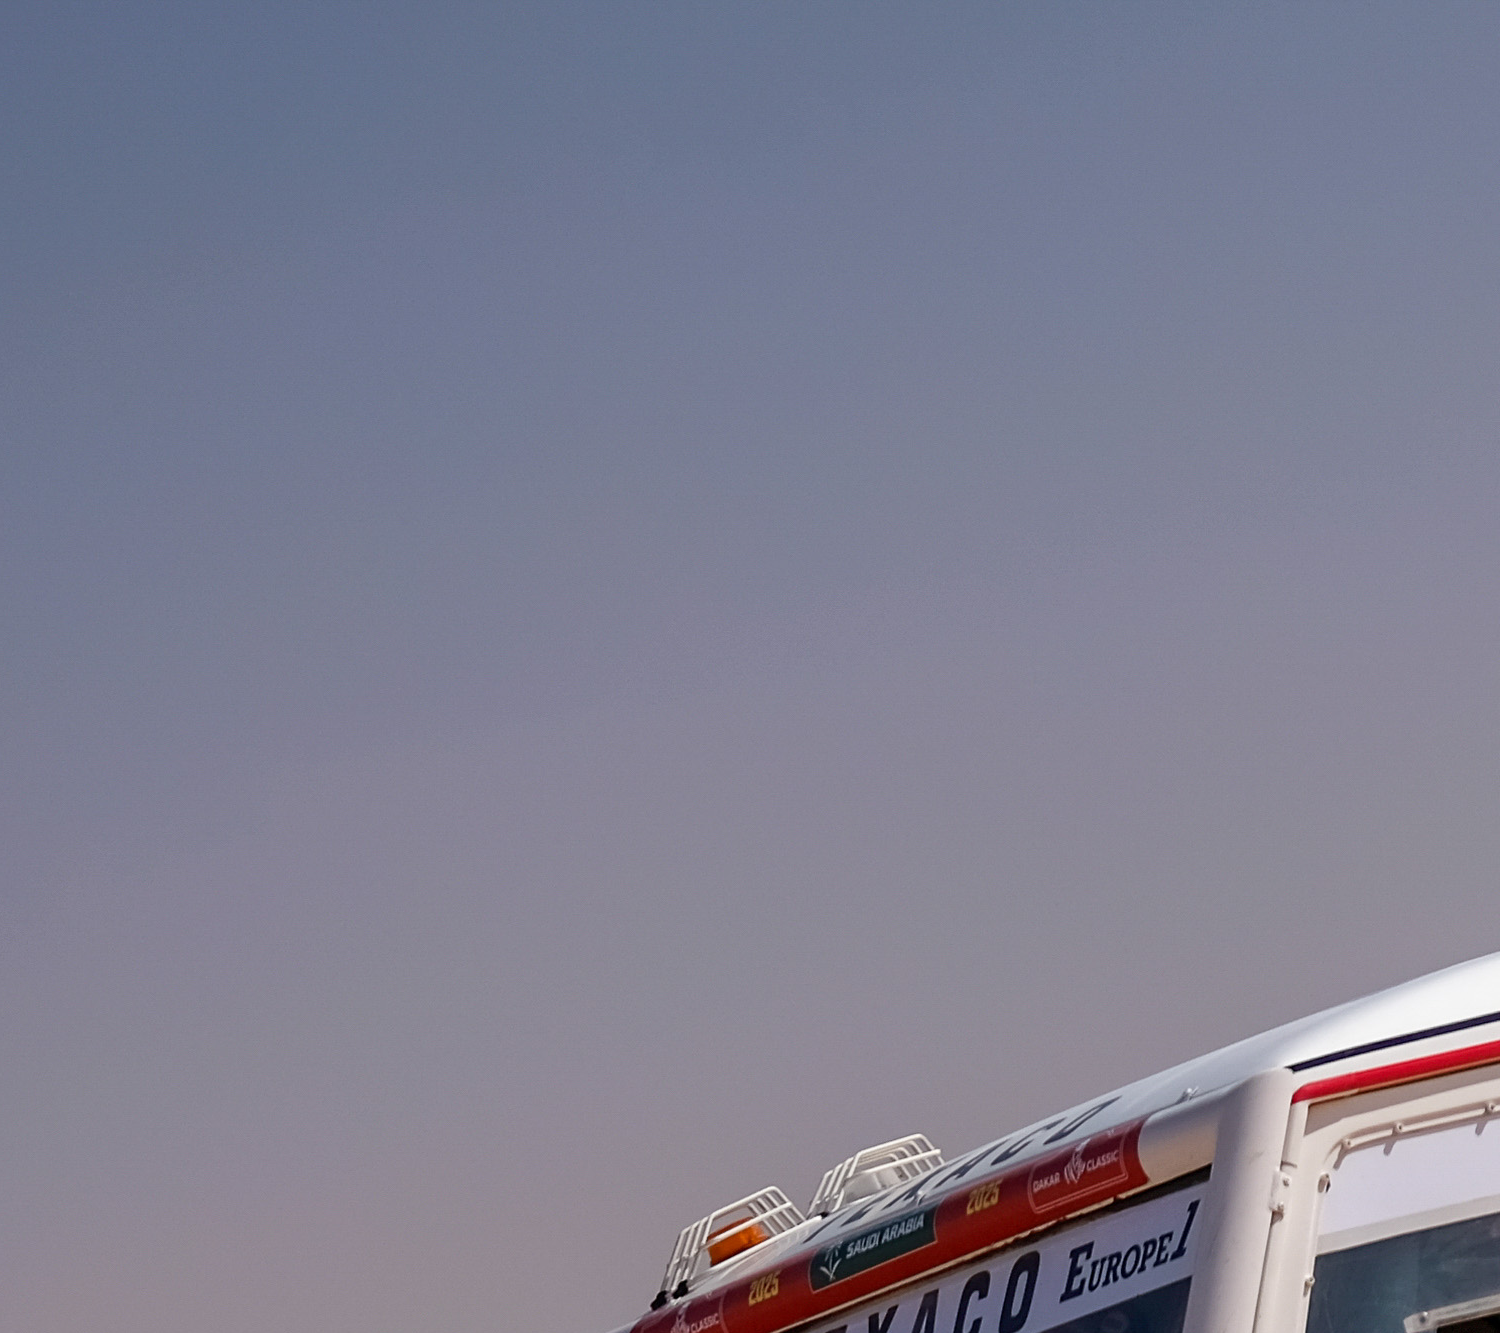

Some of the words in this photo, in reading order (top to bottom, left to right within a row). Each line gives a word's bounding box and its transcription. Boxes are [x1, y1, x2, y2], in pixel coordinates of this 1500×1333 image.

[1032, 1171, 1061, 1194] DAKAR
[1086, 1149, 1119, 1172] CLASSIC
[966, 1179, 1003, 1215] 2025
[846, 1231, 880, 1259] SAUDI
[881, 1213, 925, 1245] ARABIA
[749, 1272, 780, 1306] 2025
